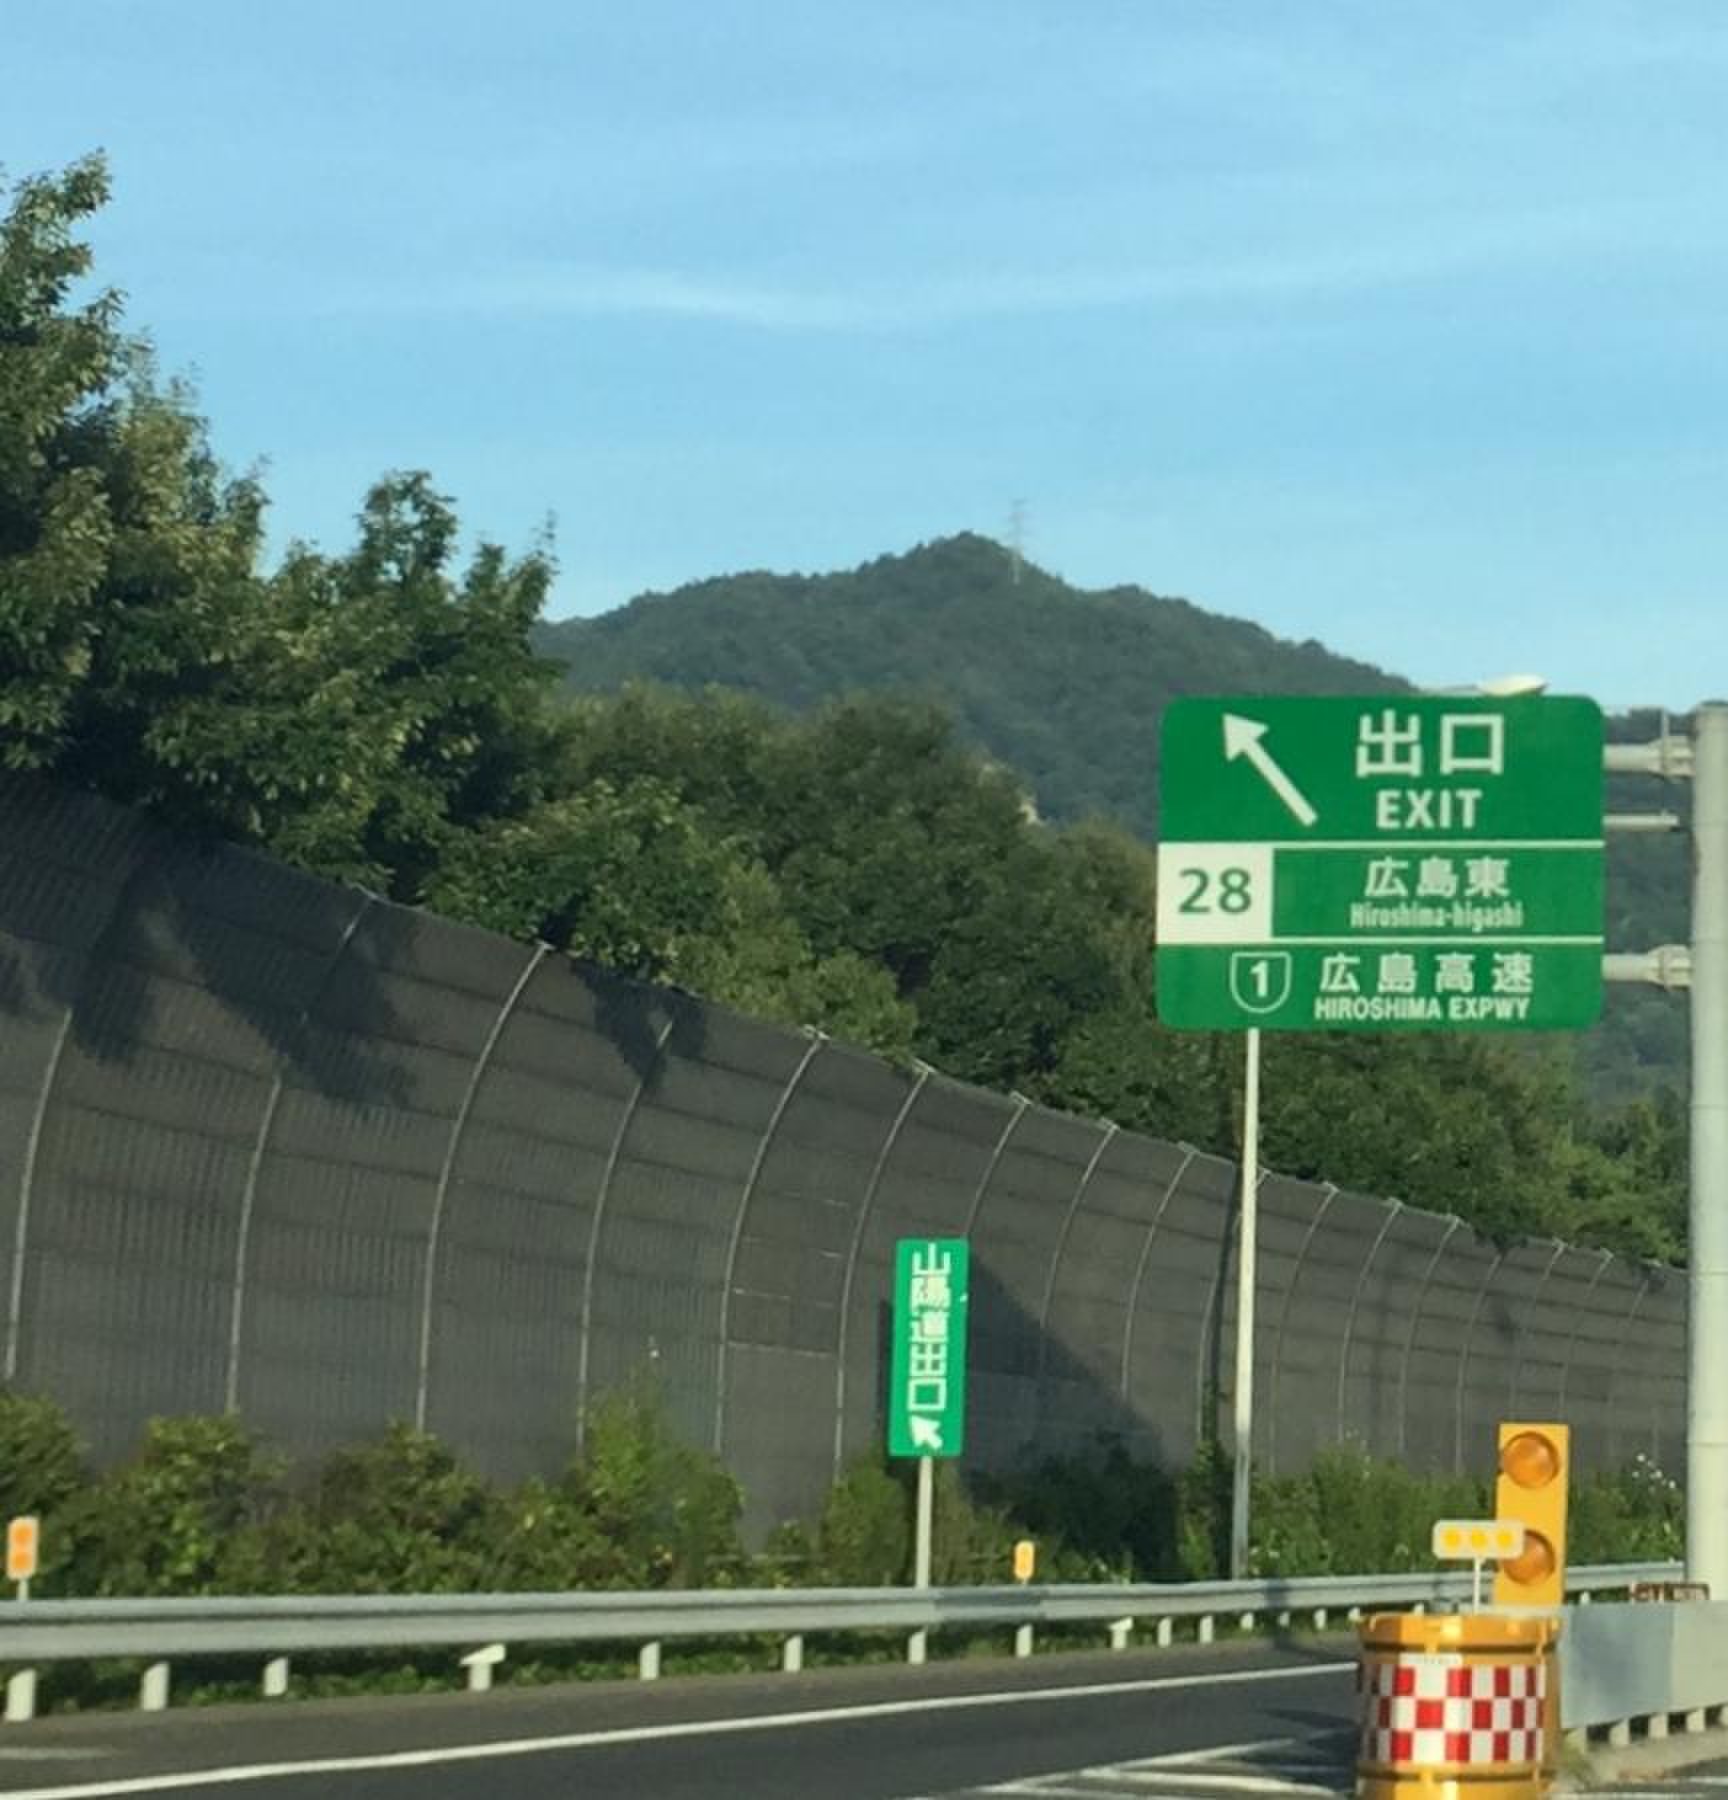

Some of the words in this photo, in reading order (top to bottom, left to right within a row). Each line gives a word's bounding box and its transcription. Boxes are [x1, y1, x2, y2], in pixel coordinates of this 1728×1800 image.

[1355, 709, 1504, 776] 出口
[1376, 789, 1482, 829] EXIT
[1177, 867, 1252, 914] 28
[1364, 856, 1510, 898] 広島東
[1350, 901, 1523, 932] Hiroshima-higashi
[1250, 960, 1268, 997] 1
[1320, 953, 1533, 993] 広島高速
[1314, 997, 1441, 1020] HIROSHIMA
[1449, 996, 1530, 1020] EXPWY
[907, 1242, 951, 1412] 山陽道出口
